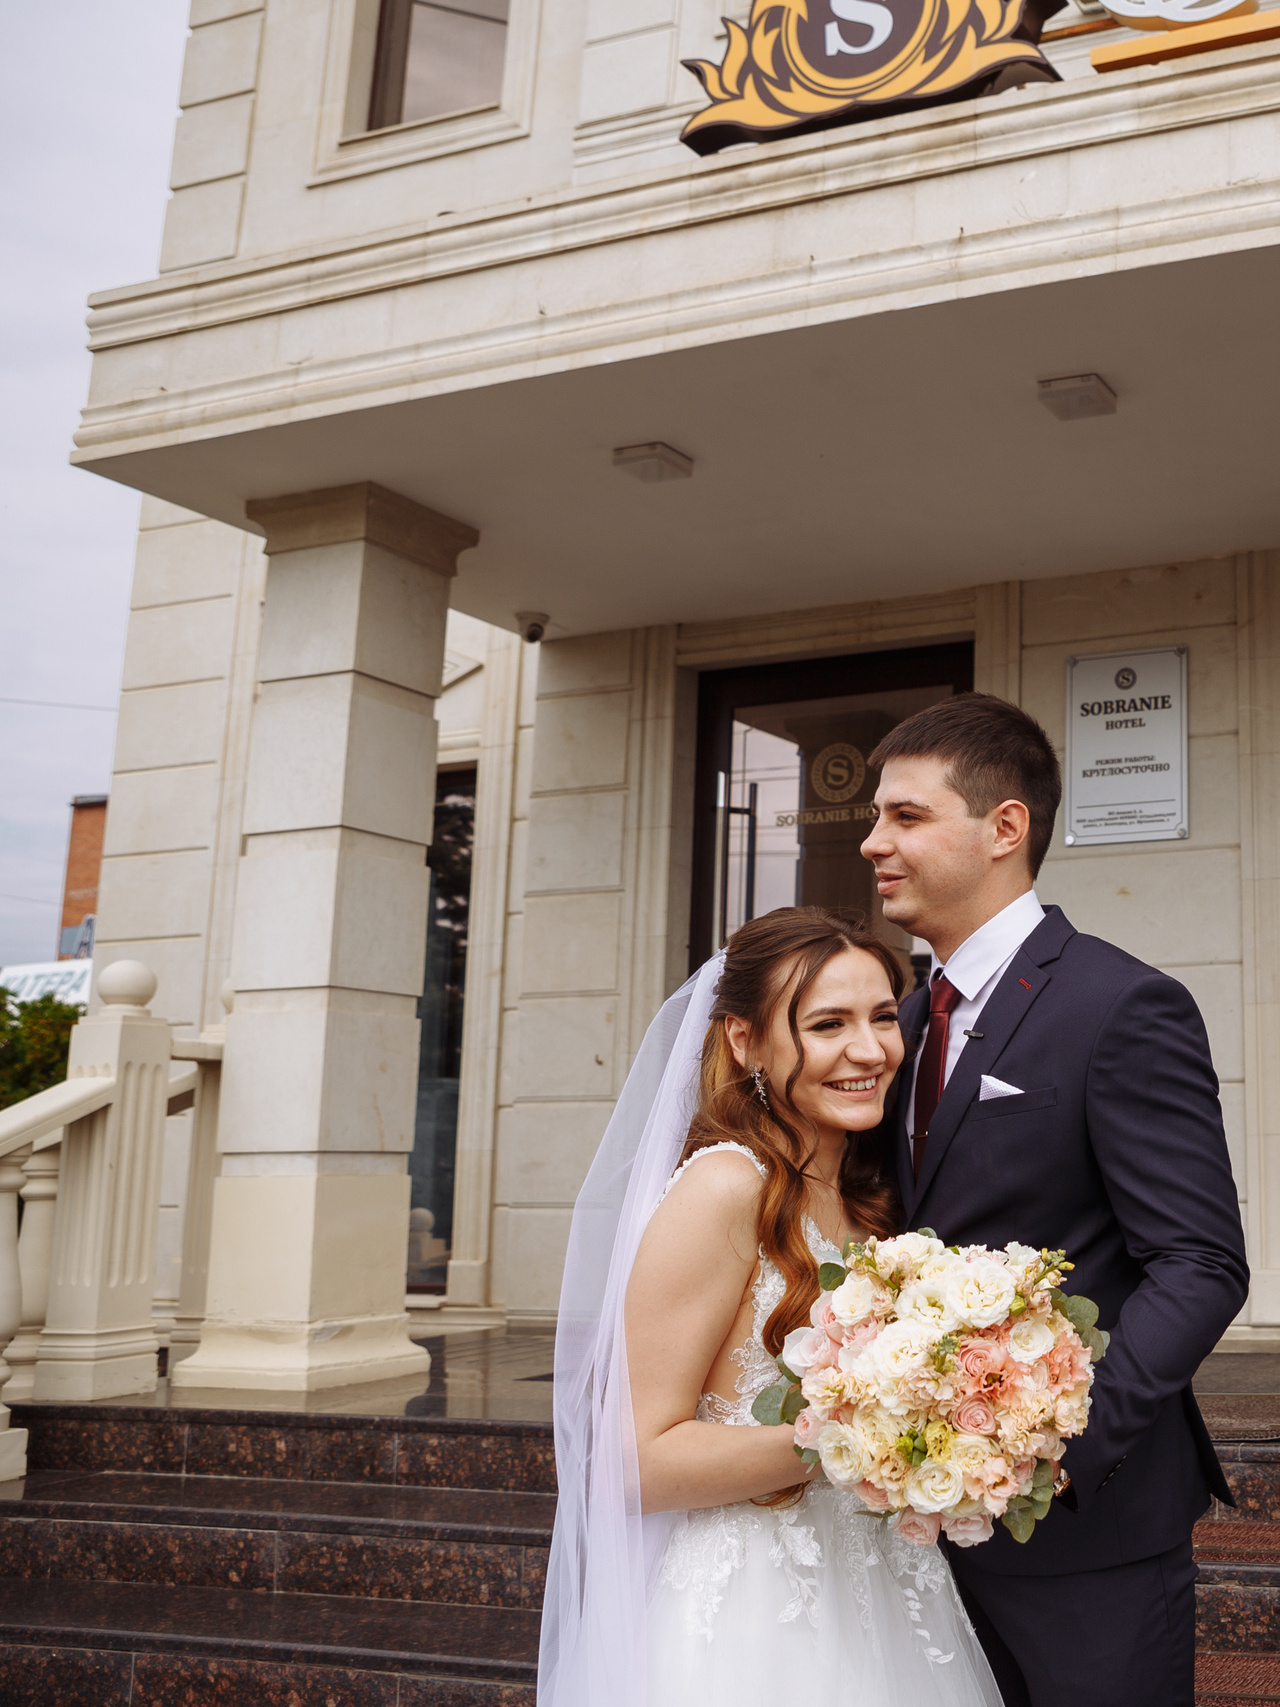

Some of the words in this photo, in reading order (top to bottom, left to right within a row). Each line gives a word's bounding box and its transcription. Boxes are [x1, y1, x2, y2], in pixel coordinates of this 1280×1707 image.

[1080, 695, 1172, 717] SOBRANIE
[1105, 718, 1146, 730] HOTEL
[827, 759, 849, 786] S
[1082, 763, 1170, 778] КРУГЛОСУТОЧНО
[776, 810, 850, 827] SOBRANIE
